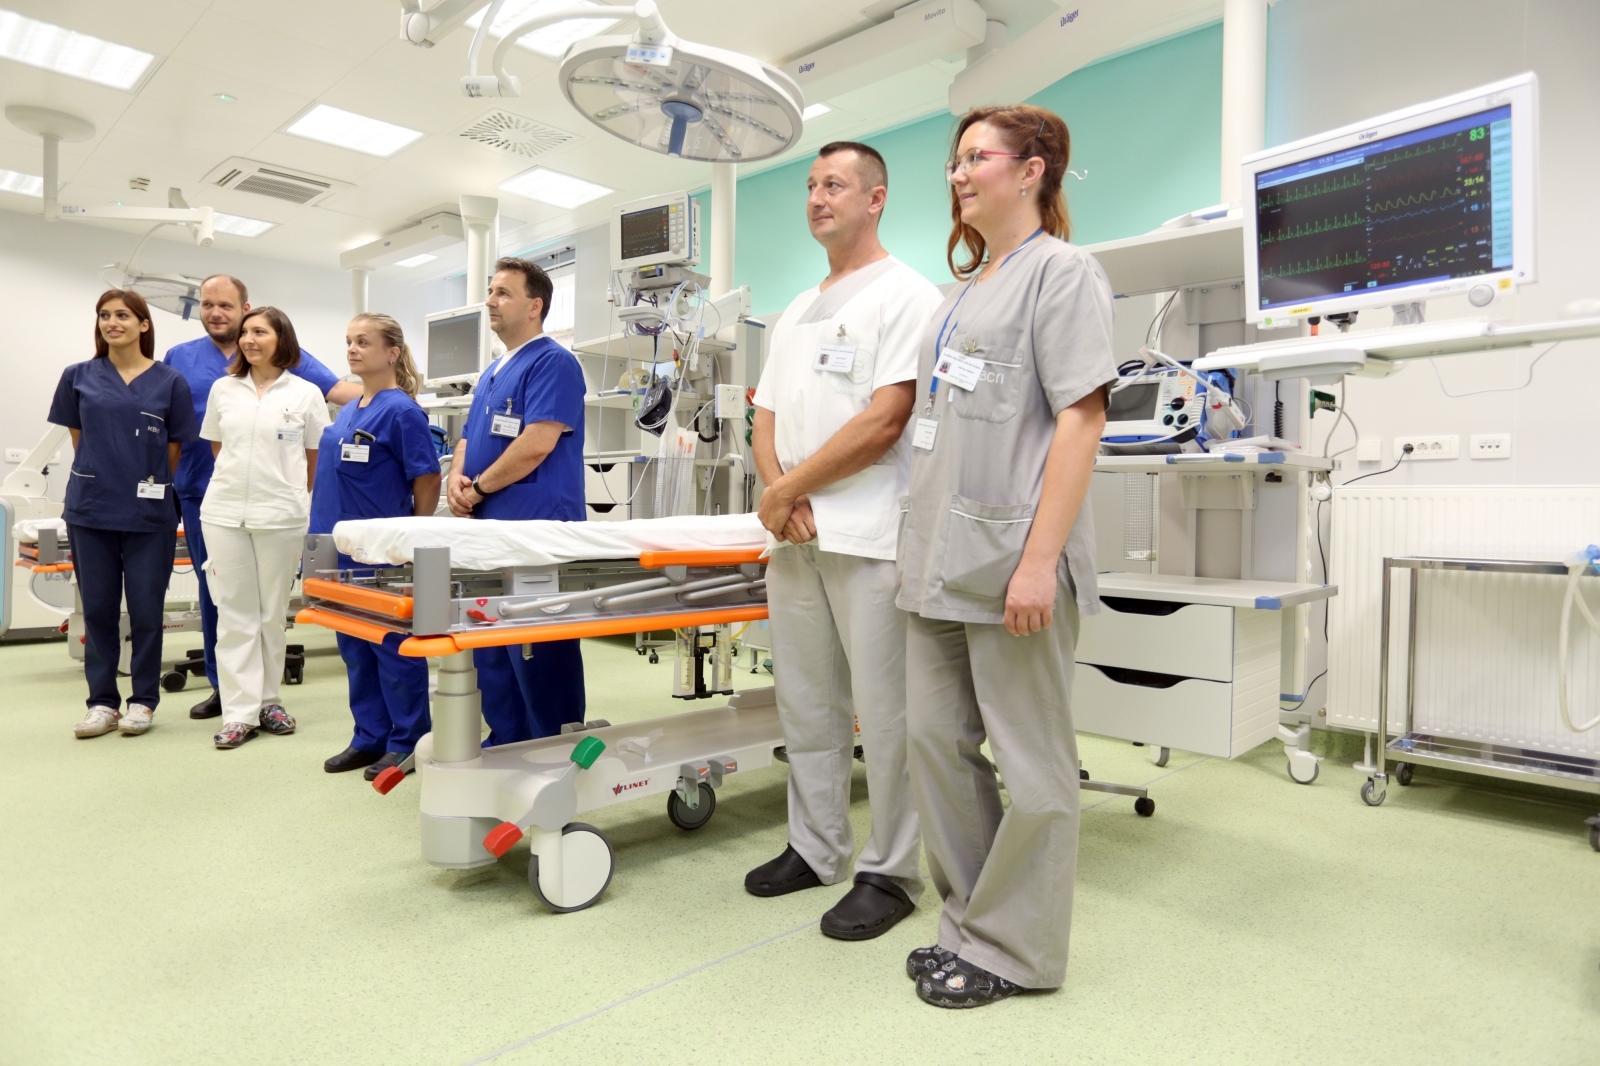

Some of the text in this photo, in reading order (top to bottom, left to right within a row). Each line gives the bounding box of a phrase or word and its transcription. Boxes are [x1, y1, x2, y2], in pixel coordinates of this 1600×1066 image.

[924, 7, 946, 22] Movita
[1060, 9, 1080, 27] Dräger
[798, 61, 816, 74] Dräger
[1469, 126, 1485, 141] 83
[624, 780, 648, 790] LINET
